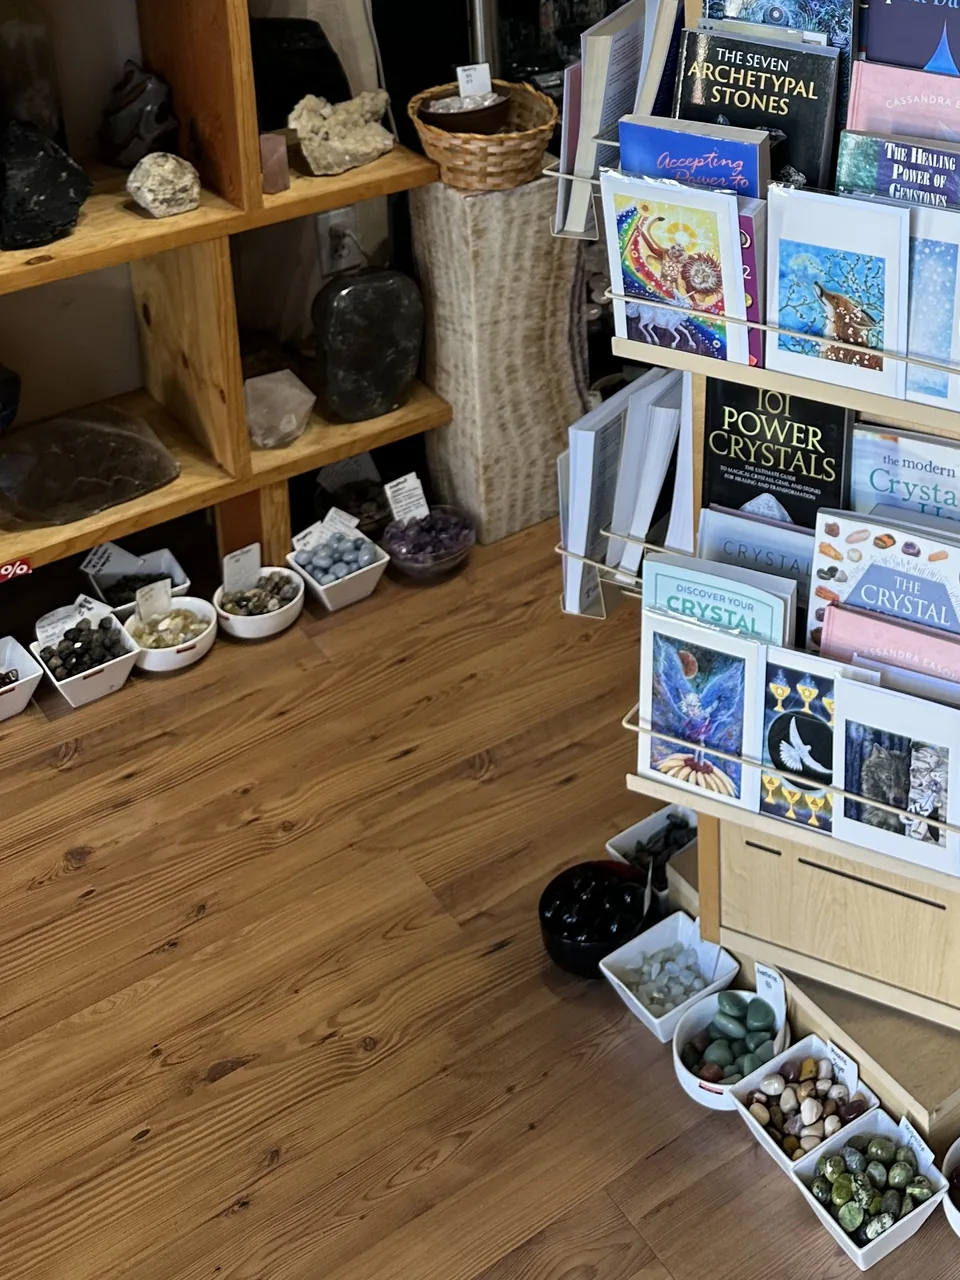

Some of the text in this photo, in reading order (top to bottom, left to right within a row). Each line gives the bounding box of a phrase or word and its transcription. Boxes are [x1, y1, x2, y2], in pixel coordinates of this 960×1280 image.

[715, 47, 790, 73] THE SEVEN
[687, 60, 819, 100] ARCHETYPAL
[710, 85, 790, 116] STONES
[885, 94, 952, 110] CASSANDRA
[656, 149, 744, 177] Accepting
[885, 142, 957, 172] THE HEALING
[731, 173, 749, 189] to
[891, 163, 947, 189] POWER OF
[888, 183, 948, 208] GEMSTONES
[755, 387, 792, 417] 101
[721, 405, 825, 454] POWER
[708, 429, 837, 483] CRYSTALS
[883, 454, 900, 467] the
[902, 456, 956, 479] modern
[720, 464, 728, 472] TO
[791, 481, 803, 490] AND
[723, 472, 734, 480] FOR
[757, 480, 770, 489] AND
[744, 464, 797, 482] THE ULTIMATE GUIDE
[676, 583, 755, 613] DISCOVER YOUR
[893, 575, 922, 596] THE
[666, 595, 762, 637] CRYSTAL
[860, 583, 951, 627] CRYSTAL
